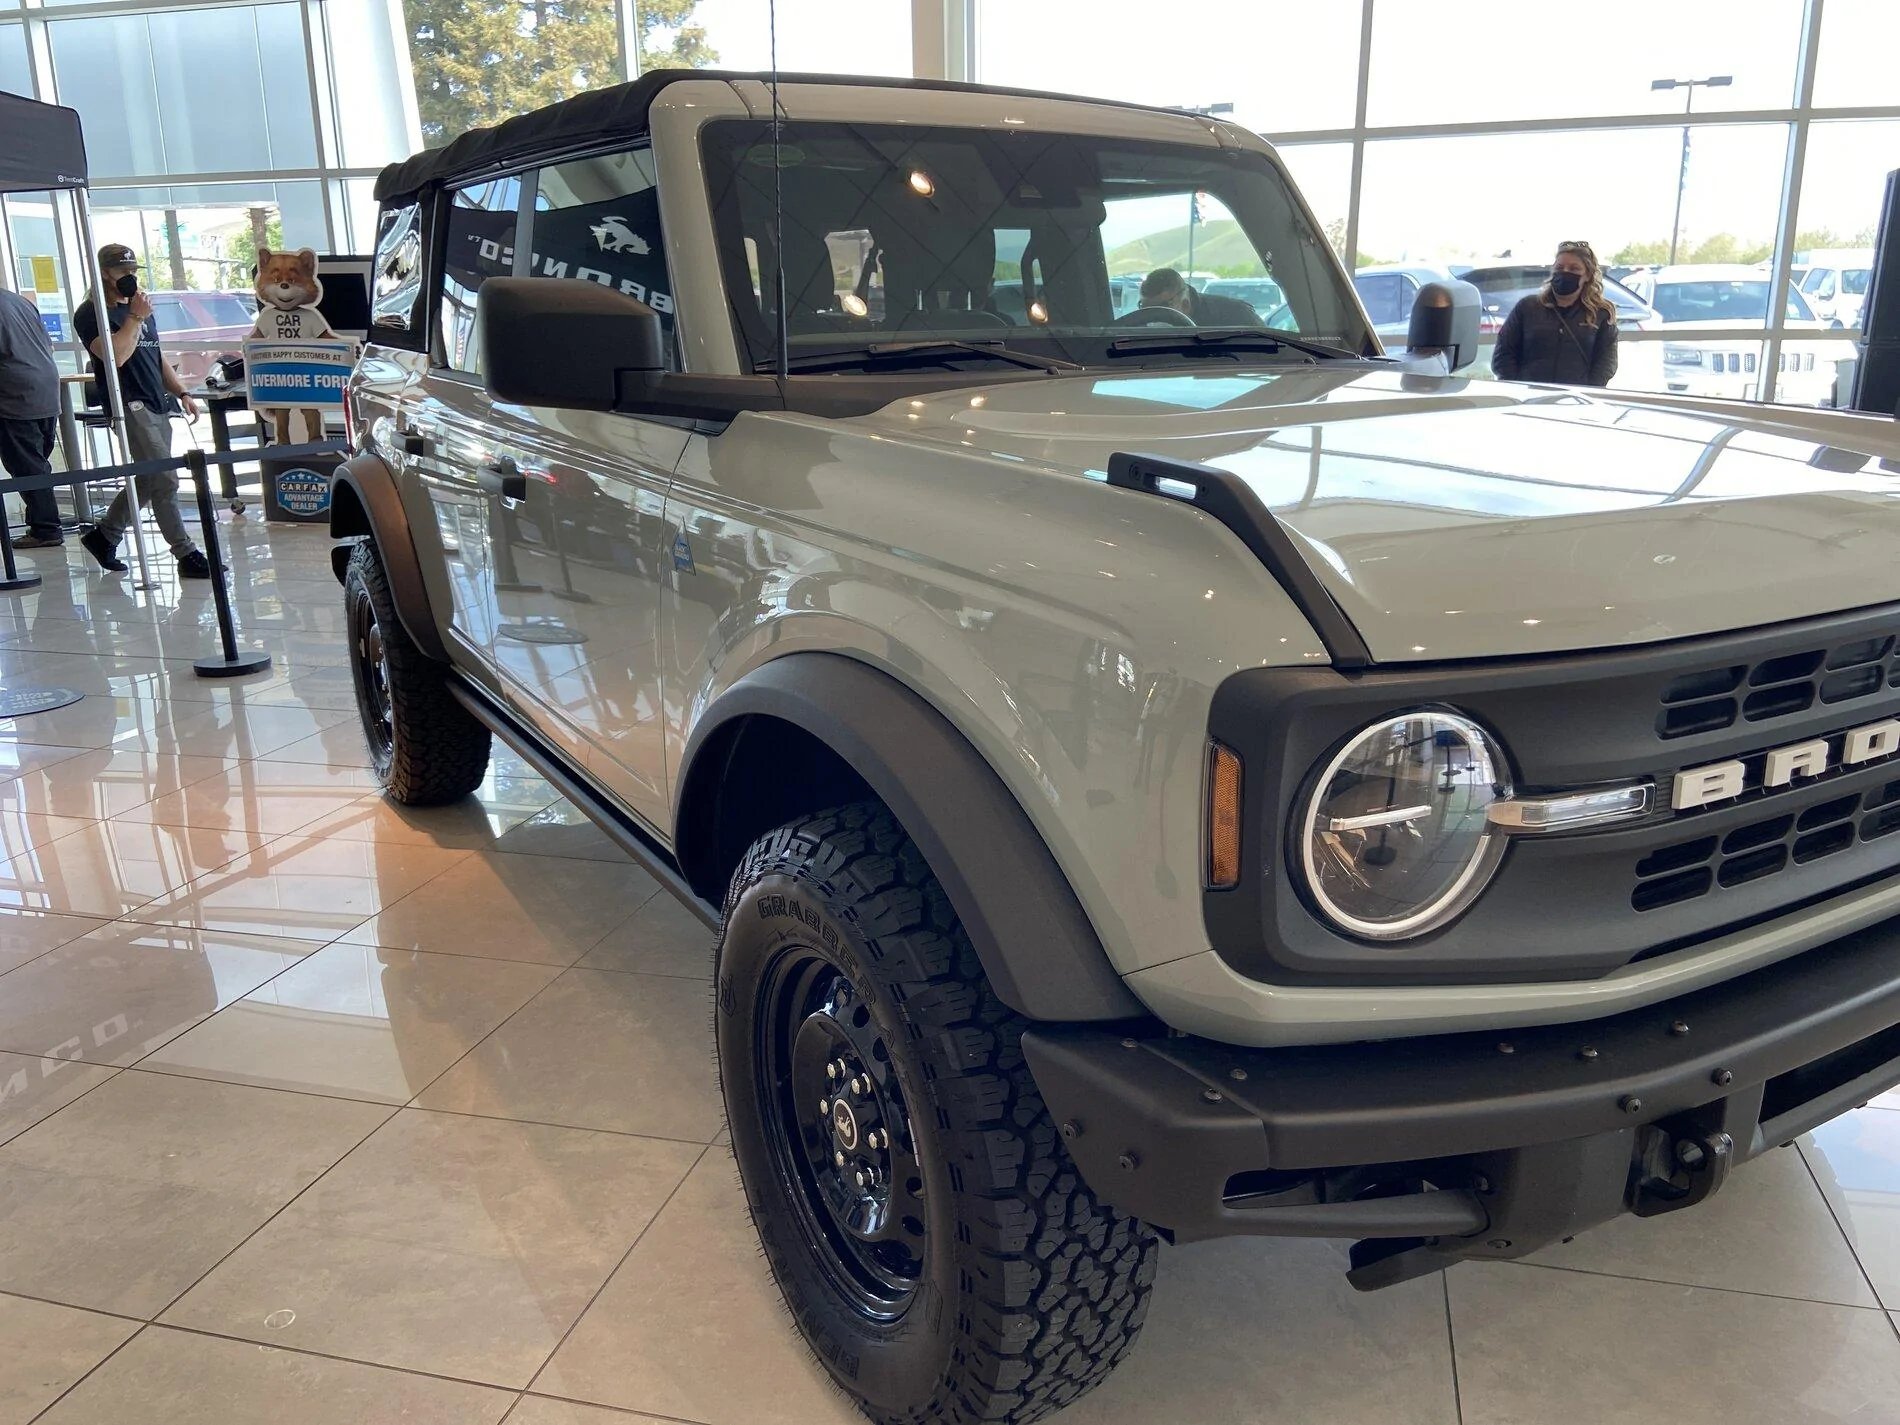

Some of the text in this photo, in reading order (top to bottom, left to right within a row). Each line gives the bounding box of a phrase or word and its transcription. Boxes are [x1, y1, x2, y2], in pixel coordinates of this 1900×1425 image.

[275, 314, 301, 326] CAR
[277, 327, 301, 339] FOX
[272, 351, 292, 359] HAPPY
[293, 351, 331, 360] CUSTOMER
[251, 374, 350, 388] LIVERMORE FORD
[280, 482, 328, 492] CARFAX
[284, 493, 325, 502] ADVANTAGE
[291, 502, 318, 510] DEALER
